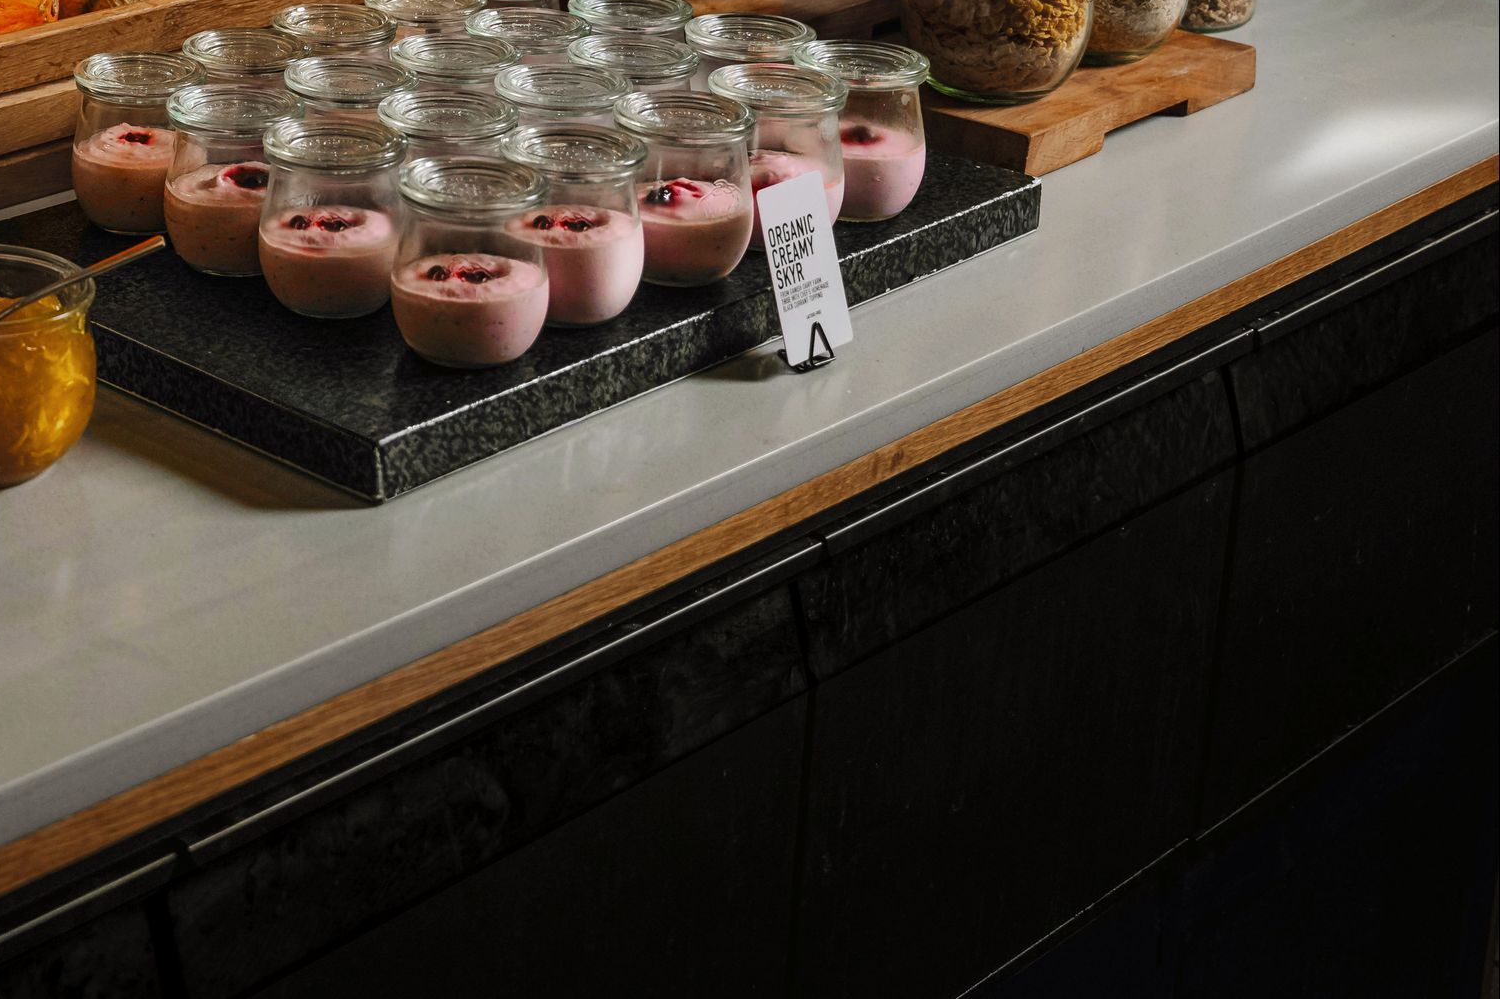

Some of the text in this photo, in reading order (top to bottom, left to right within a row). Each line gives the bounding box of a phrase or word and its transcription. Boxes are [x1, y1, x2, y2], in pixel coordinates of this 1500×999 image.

[768, 214, 814, 247] ORGANIC
[772, 236, 813, 268] CREAMY
[776, 263, 804, 289] SKYR
